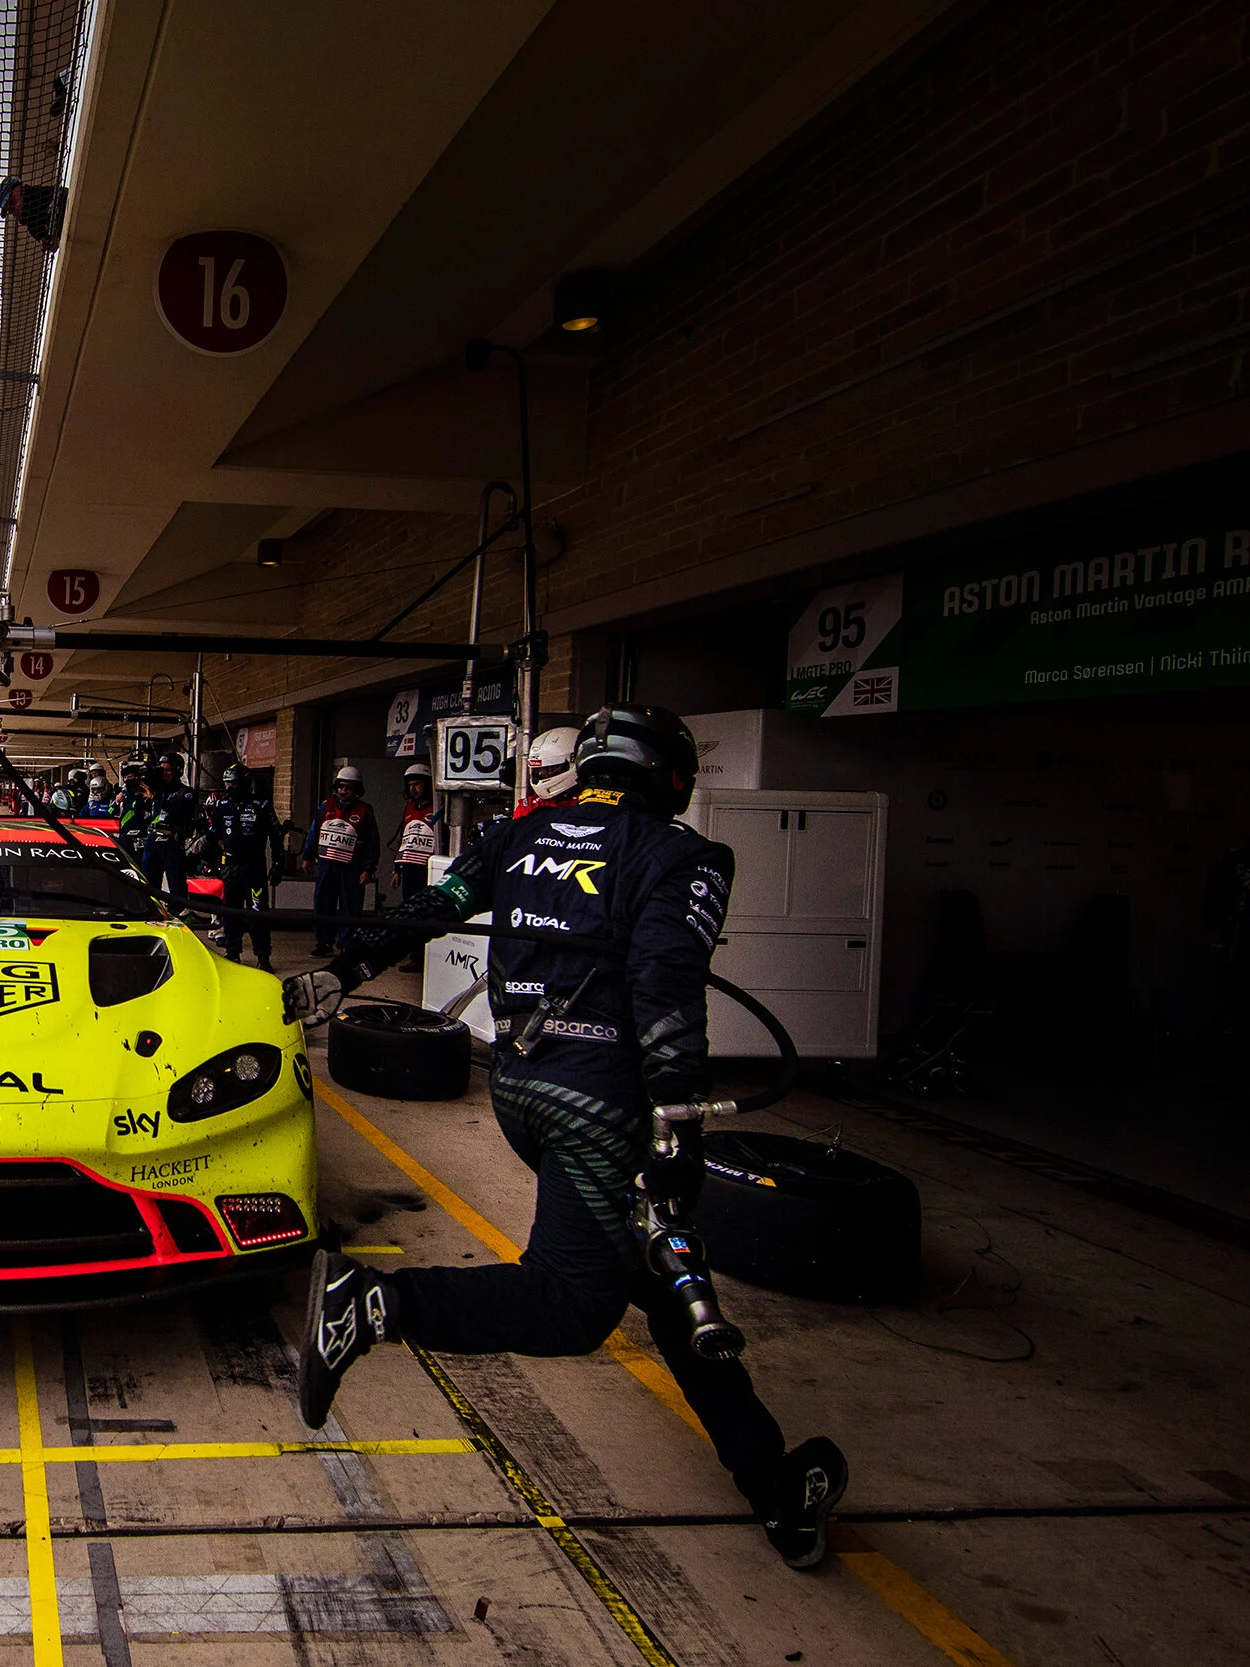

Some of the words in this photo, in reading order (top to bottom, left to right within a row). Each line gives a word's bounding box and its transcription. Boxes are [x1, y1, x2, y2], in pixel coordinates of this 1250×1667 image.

[198, 256, 251, 330] 16
[942, 570, 1042, 617] ASTON
[1051, 536, 1208, 599] MARTIN
[63, 575, 86, 606] 15
[1029, 607, 1072, 626] Aston
[1076, 597, 1130, 619] Martin
[1133, 587, 1207, 610] Vantage
[818, 601, 866, 653] 95
[29, 655, 45, 676] 14
[1023, 664, 1069, 685] Marco
[1072, 658, 1145, 682] Sørensen
[1159, 651, 1203, 672] Nicki
[15, 691, 27, 705] 13
[477, 682, 502, 702] ACING
[790, 685, 829, 701] WEC
[395, 701, 410, 723] 33
[449, 730, 502, 774] 95
[699, 765, 724, 774] ARTIN
[330, 833, 354, 846] LANE
[534, 837, 566, 848] ASTON
[30, 847, 121, 863] RACIG
[506, 853, 607, 895] AMR
[524, 913, 571, 931] TOTAL
[445, 949, 479, 980] AMR
[505, 981, 545, 994] sparc
[543, 1018, 617, 1038] sparco
[113, 1108, 161, 1139] sky
[130, 1154, 211, 1182] HACKETT
[152, 1176, 195, 1190] LONDON
